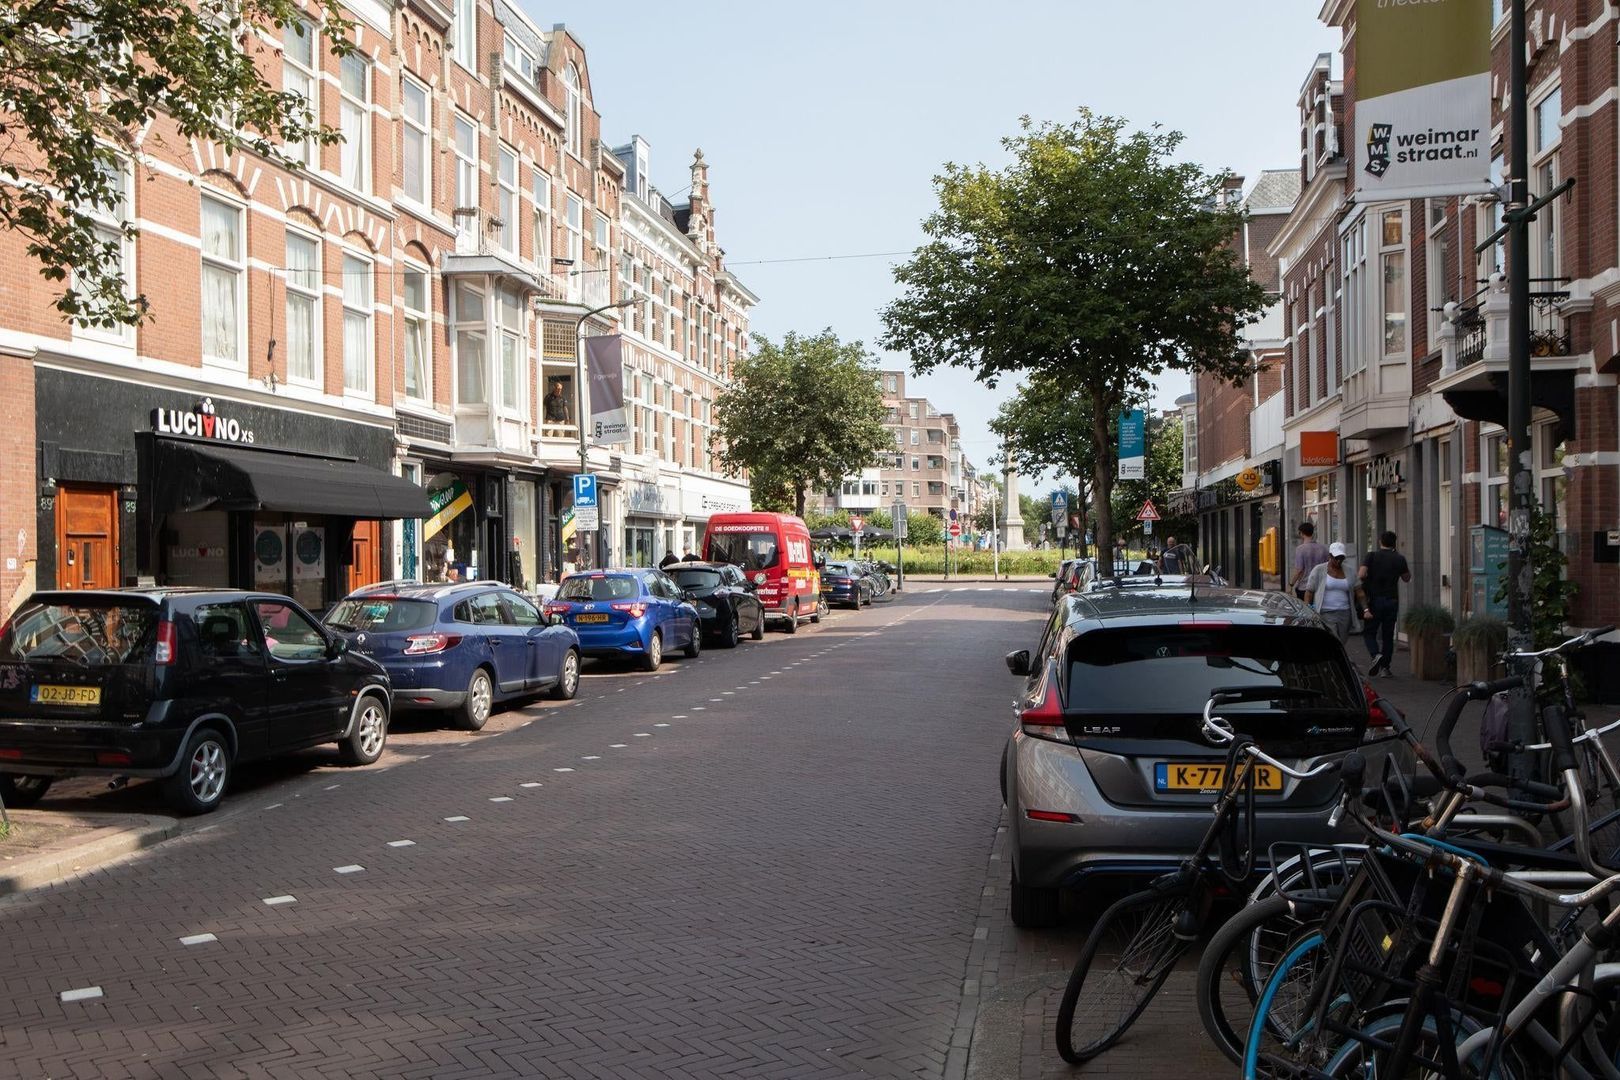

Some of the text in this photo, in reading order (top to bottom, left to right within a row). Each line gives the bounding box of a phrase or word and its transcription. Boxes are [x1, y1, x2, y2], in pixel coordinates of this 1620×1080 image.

[1396, 128, 1480, 147] weimar
[1396, 144, 1478, 163] straat.nl
[578, 477, 591, 494] P
[1083, 726, 1121, 734] LEAF
